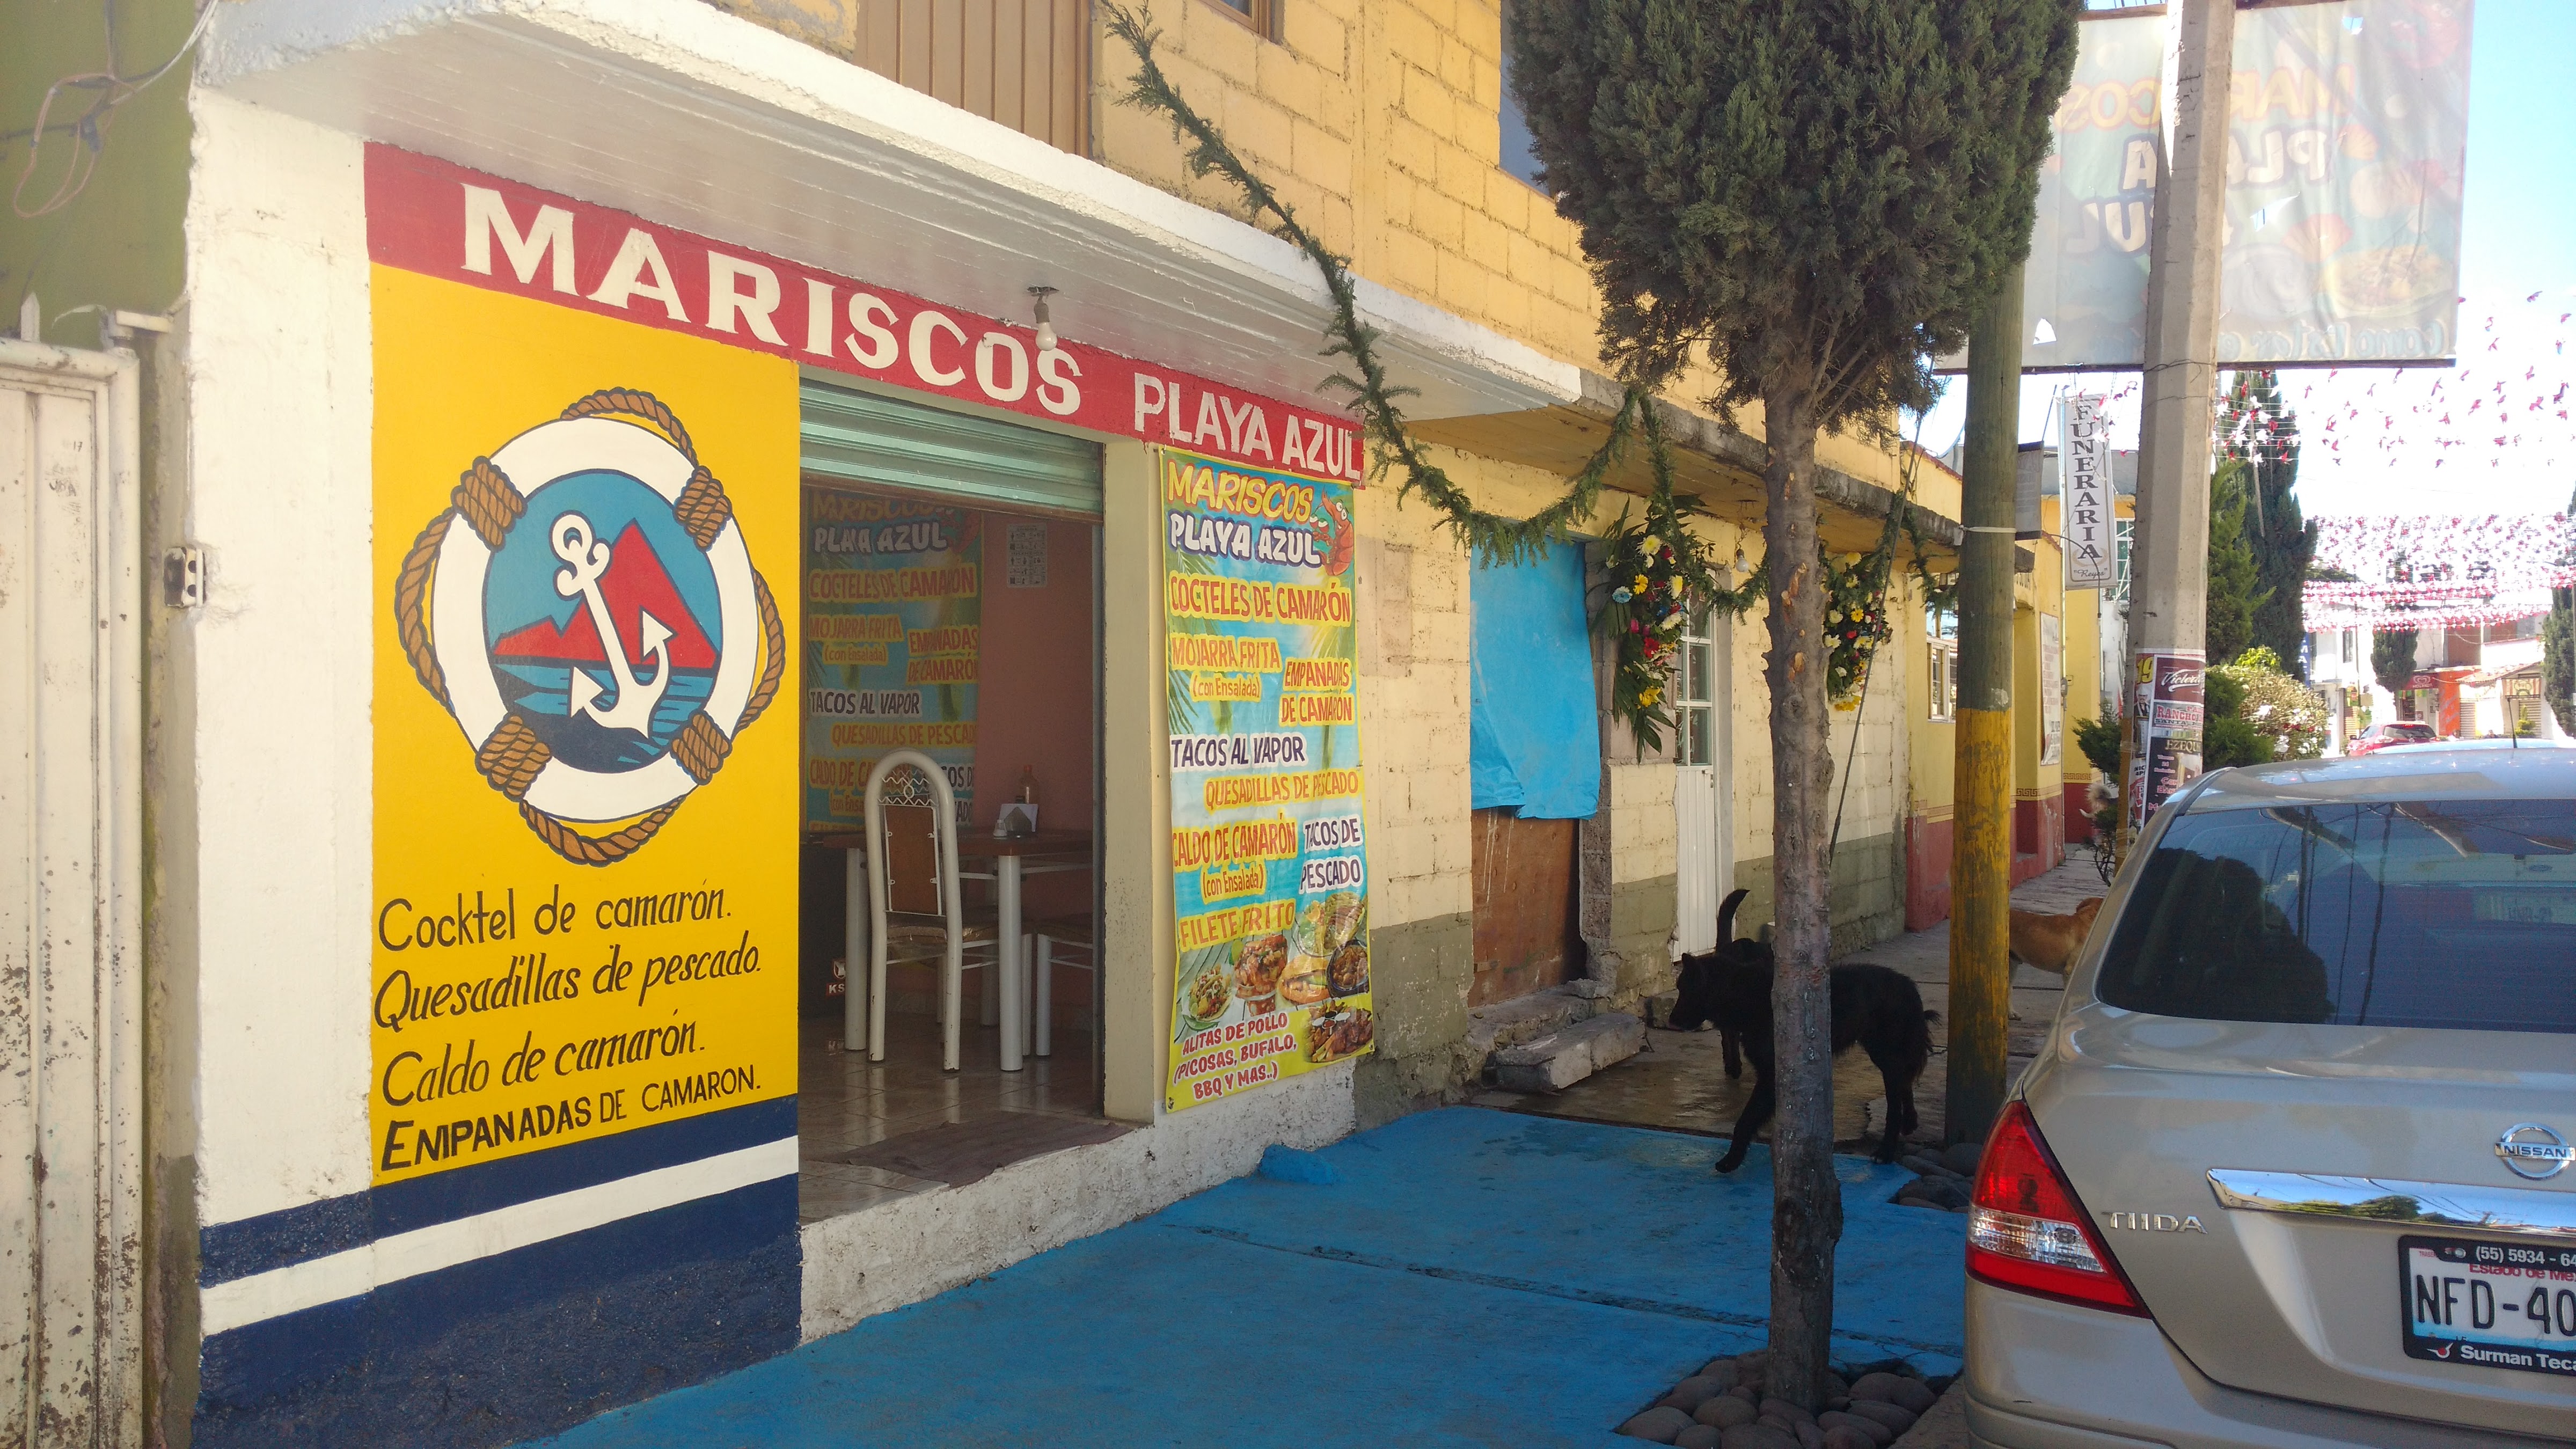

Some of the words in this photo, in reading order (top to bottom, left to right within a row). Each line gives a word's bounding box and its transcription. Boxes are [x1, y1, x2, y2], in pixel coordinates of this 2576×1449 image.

[461, 182, 1083, 415] MARISCOS
[1133, 372, 1274, 461] PLAYA
[1282, 401, 1360, 480] AZUL
[1167, 462, 1313, 523] MARISCOS
[2070, 405, 2102, 559] FUNERARIA
[877, 522, 947, 551] AZUL
[1169, 513, 1252, 557] PLAYA
[1258, 529, 1321, 564] AZUL
[881, 572, 899, 599] DE
[1170, 576, 1251, 617] COCTELES
[1252, 585, 1273, 618] DE
[1276, 582, 1351, 623] CAMARÓN
[868, 617, 903, 639] FRITA
[1172, 636, 1238, 667] MOJARRA
[1239, 641, 1281, 669] FRITA
[1192, 675, 1214, 697] (con
[1216, 676, 1261, 698] Ensalada)
[1285, 661, 1350, 687] EMPANADAS
[809, 691, 856, 715] TACOS
[860, 692, 875, 714] AL
[880, 692, 920, 714] VAPOR
[1281, 697, 1296, 723] DE
[1299, 689, 1352, 722] CAMARÓN
[832, 724, 906, 748] QUESADILLAS
[909, 724, 924, 745] DE
[1171, 738, 1228, 768] TACOS
[1231, 737, 1249, 765] AL
[1253, 736, 1306, 763] VAPOR
[839, 760, 855, 788] DE
[1206, 776, 1290, 810] QUESADILLAS
[1293, 774, 1309, 799] DE
[1313, 771, 1359, 798] PESCADO
[1214, 827, 1229, 861] DE
[1233, 813, 1296, 858] CAMARÓN
[1305, 820, 1338, 850] TACOS
[1341, 818, 1360, 844] DE
[1202, 873, 1222, 898] (con
[1223, 864, 1264, 892] Ensalada)
[1300, 859, 1361, 891] PESCADO
[378, 888, 515, 952] Cocktel
[534, 884, 575, 935] de
[596, 879, 732, 930] camarón.
[1180, 911, 1238, 947] FILETE
[1241, 902, 1295, 934] FRITO
[374, 952, 581, 1033] Quesadillas
[592, 944, 633, 994] de
[638, 930, 762, 1007] pescado.
[1182, 1028, 1221, 1056] ALITAS
[1225, 1021, 1245, 1042] DE
[1247, 1012, 1287, 1036] POLLO
[382, 1039, 490, 1107] Caldo
[502, 1030, 547, 1089] de
[554, 1008, 705, 1075] camarón.
[1173, 1049, 1237, 1084] (PICOSAS,
[1240, 1034, 1297, 1063] BUFALO,
[1193, 1077, 1223, 1100] BBQ
[1225, 1073, 1234, 1091] Y
[1238, 1061, 1278, 1087] MAS..)
[380, 1096, 591, 1171] EMPANADAS
[601, 1089, 627, 1123] DE
[641, 1064, 762, 1113] CAMARON.
[2504, 1145, 2566, 1158] NISSAN
[2101, 1211, 2208, 1234] TIIDA
[2476, 1246, 2504, 1263] (55)
[2508, 1249, 2545, 1264] 5934
[2417, 1275, 2576, 1336] NFD-40
[2461, 1345, 2533, 1366] Surman
